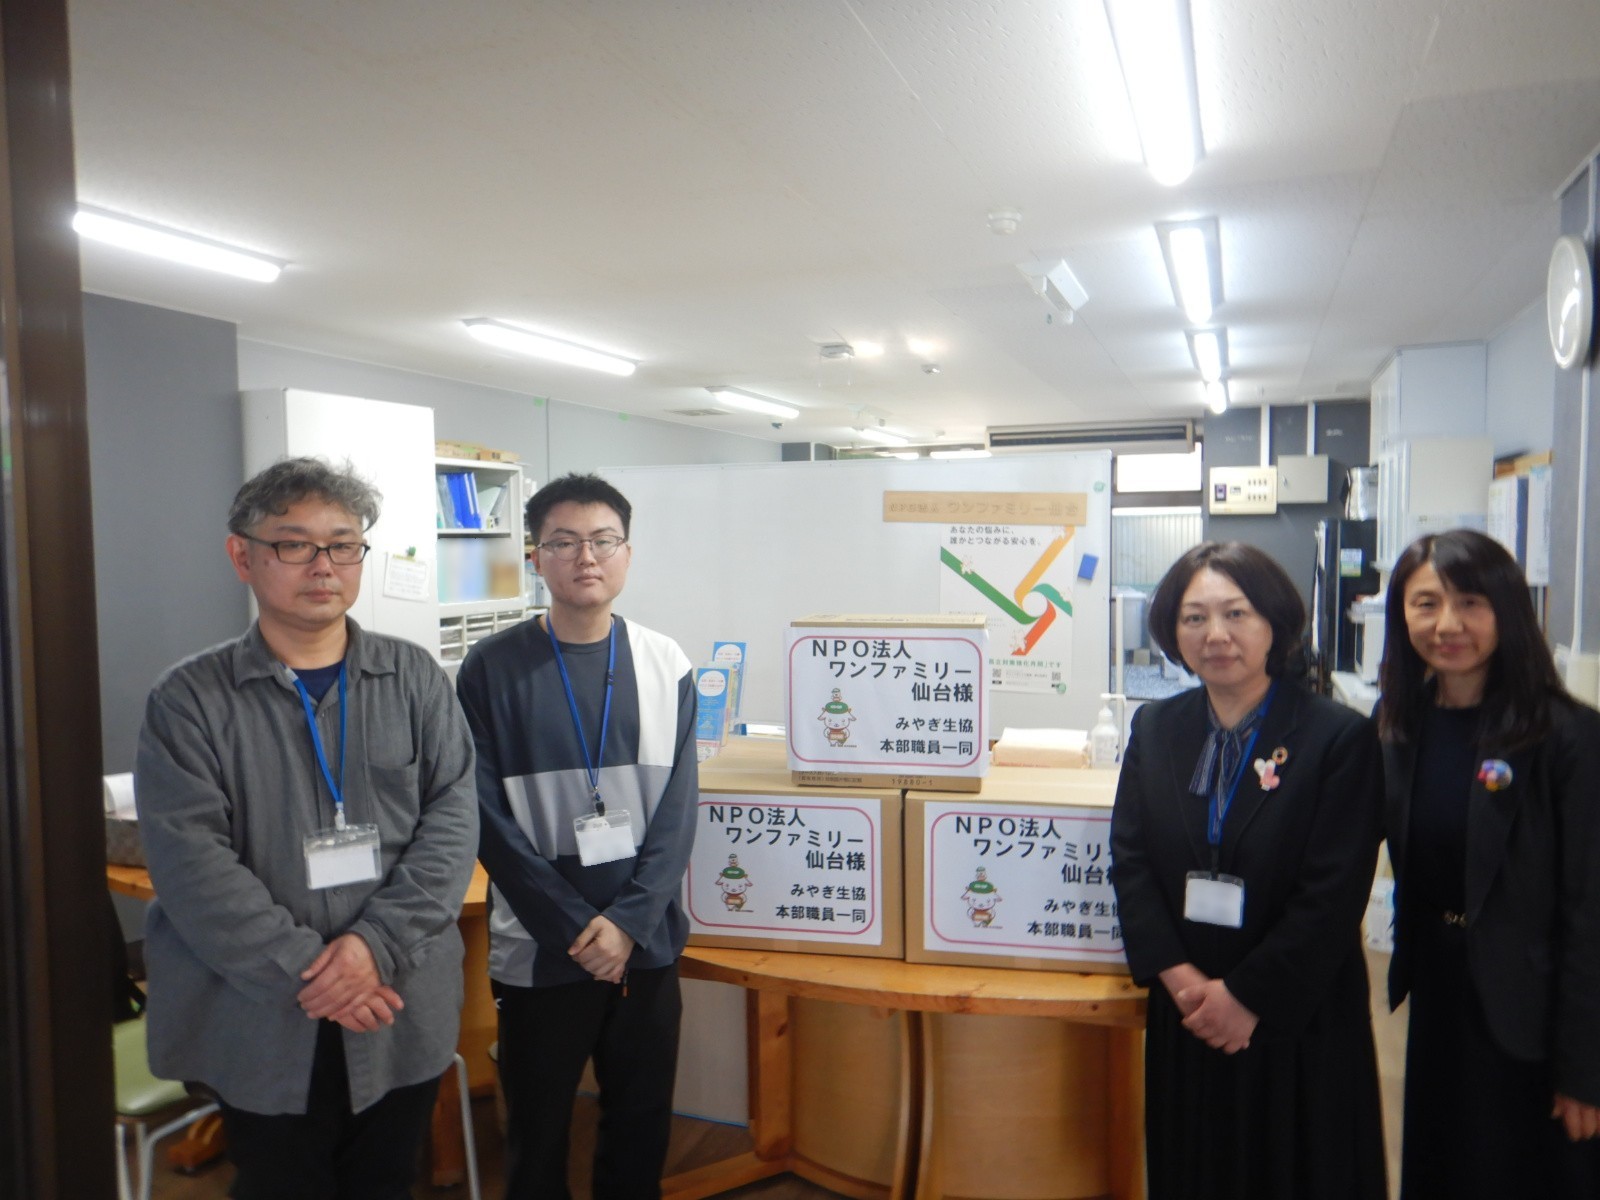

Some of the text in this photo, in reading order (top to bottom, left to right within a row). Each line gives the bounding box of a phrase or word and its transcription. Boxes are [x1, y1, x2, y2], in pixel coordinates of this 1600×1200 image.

[950, 526, 1015, 535] あなたの悩みに、
[949, 536, 1041, 546] 誰かとつながる安心を。
[812, 639, 912, 659] NPO法人
[829, 661, 972, 680] ワンファミリー
[911, 683, 974, 702] 仙台様
[895, 717, 974, 733] みやぎ生協
[880, 739, 973, 756] 本部職員一同
[709, 806, 806, 827] NPO法人
[956, 816, 1062, 839] NPO法人
[726, 827, 863, 849] ワンファミリー
[974, 839, 1113, 862] ワンファミリ
[806, 850, 866, 871] 仙台様
[790, 884, 866, 901] みやぎ生協
[776, 905, 866, 924] 本部職員一同
